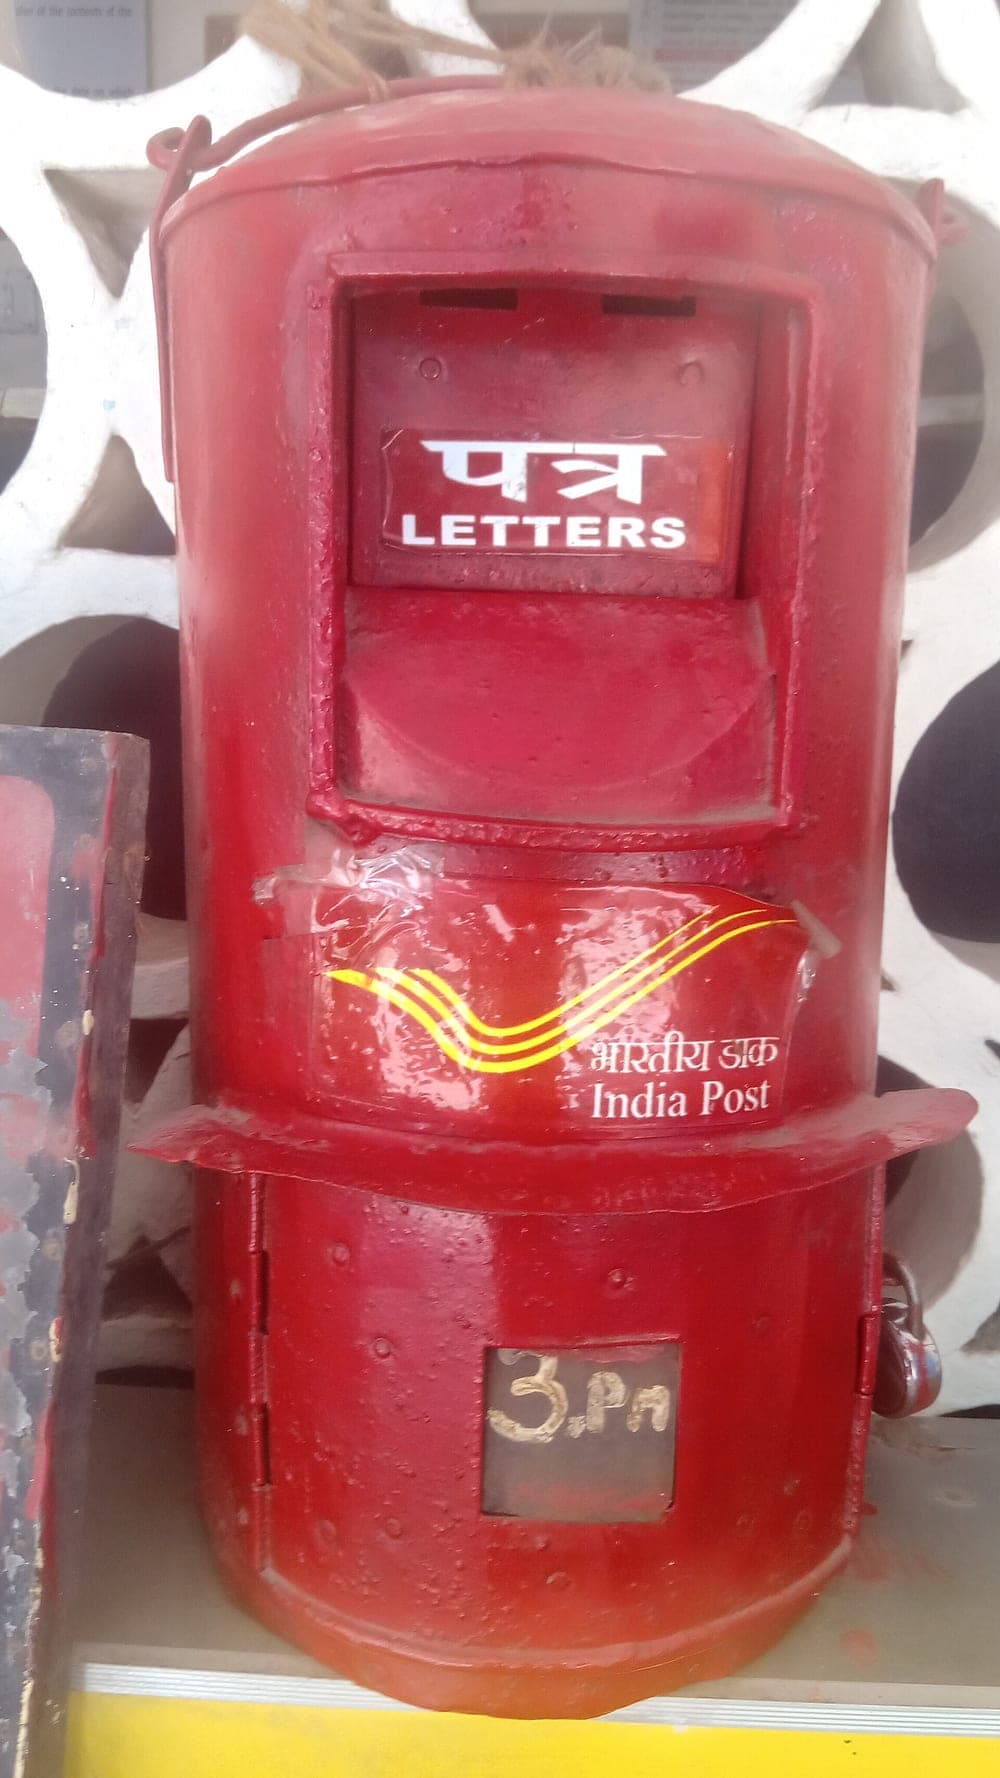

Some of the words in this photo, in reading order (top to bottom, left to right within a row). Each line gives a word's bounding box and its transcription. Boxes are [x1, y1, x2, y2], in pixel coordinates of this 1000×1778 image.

[420, 440, 667, 505] पत्र
[402, 514, 686, 549] LETTERS
[590, 1030, 715, 1073] भारतीय
[719, 1036, 781, 1069] डाक
[592, 1081, 688, 1119] India
[699, 1079, 772, 1116] Post
